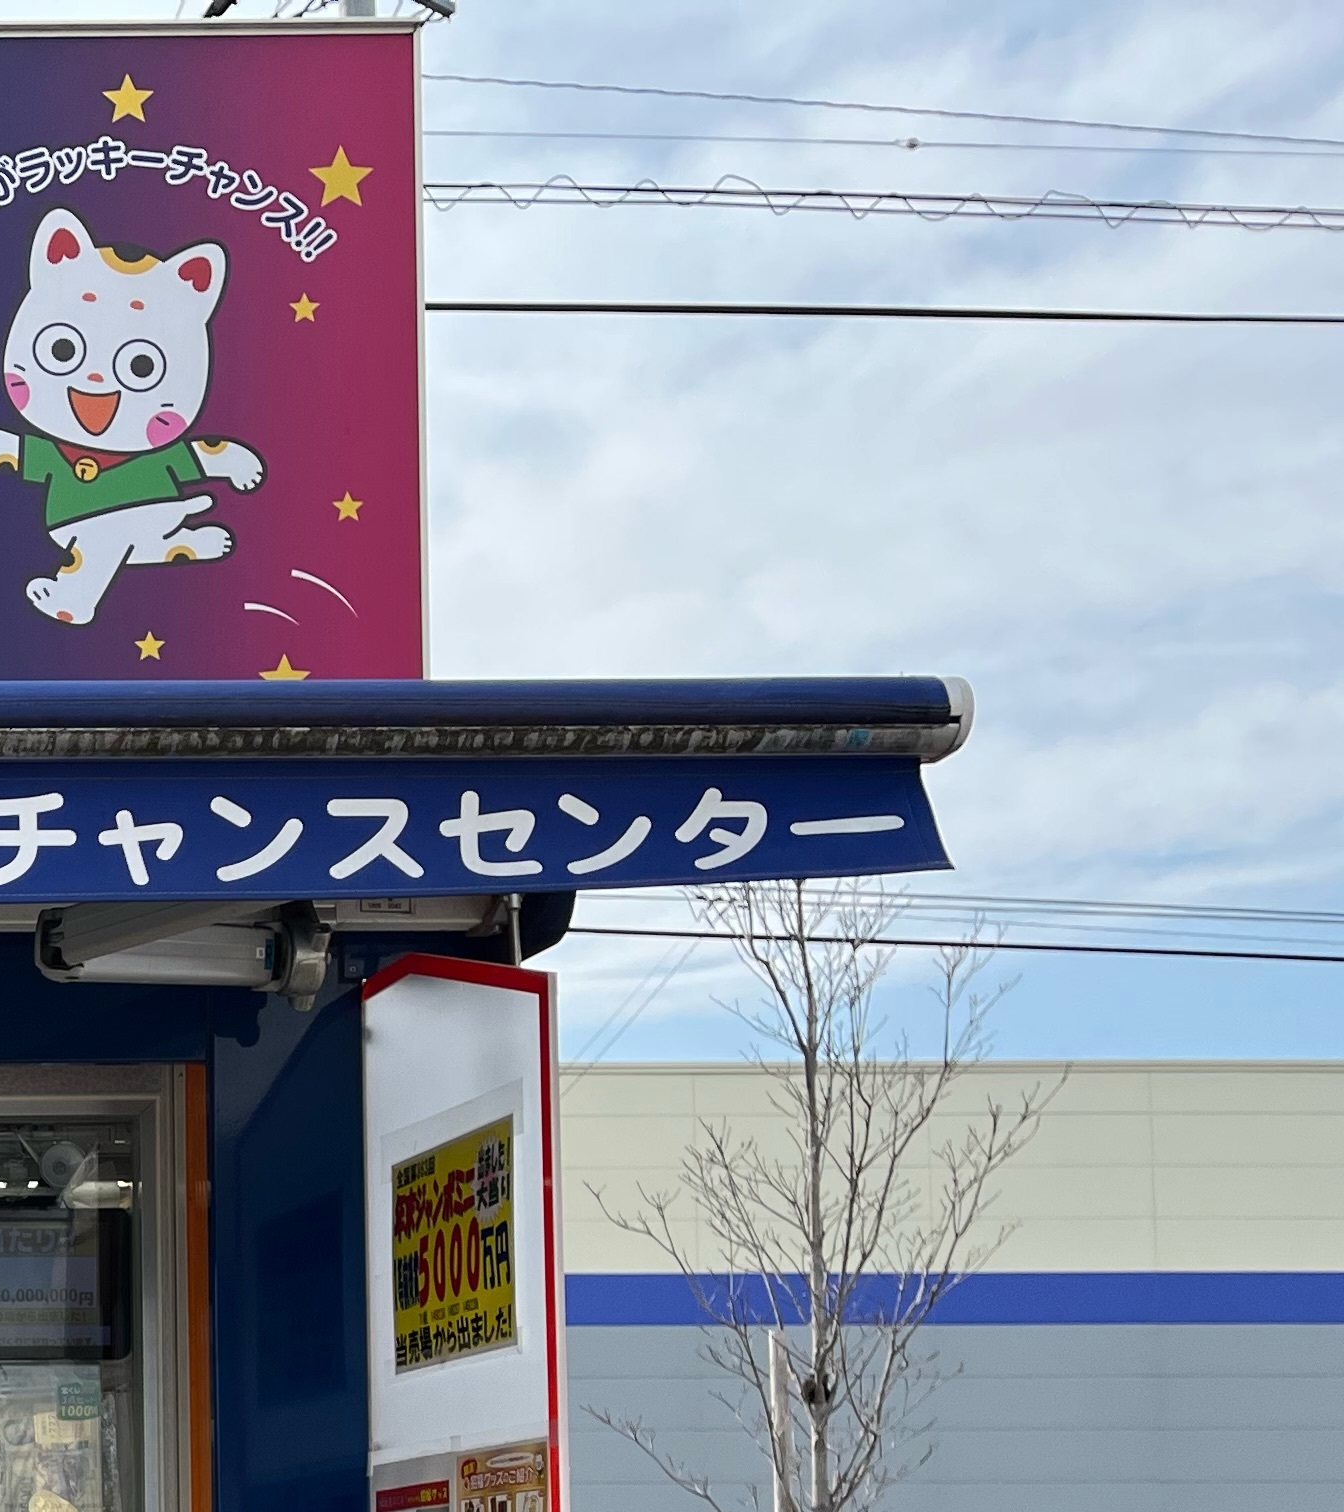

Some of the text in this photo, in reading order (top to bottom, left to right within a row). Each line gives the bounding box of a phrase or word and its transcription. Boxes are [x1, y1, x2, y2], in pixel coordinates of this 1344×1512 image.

[419, 1217, 511, 1308] 5000万円
[396, 1303, 512, 1366] 当売場から出ました!
